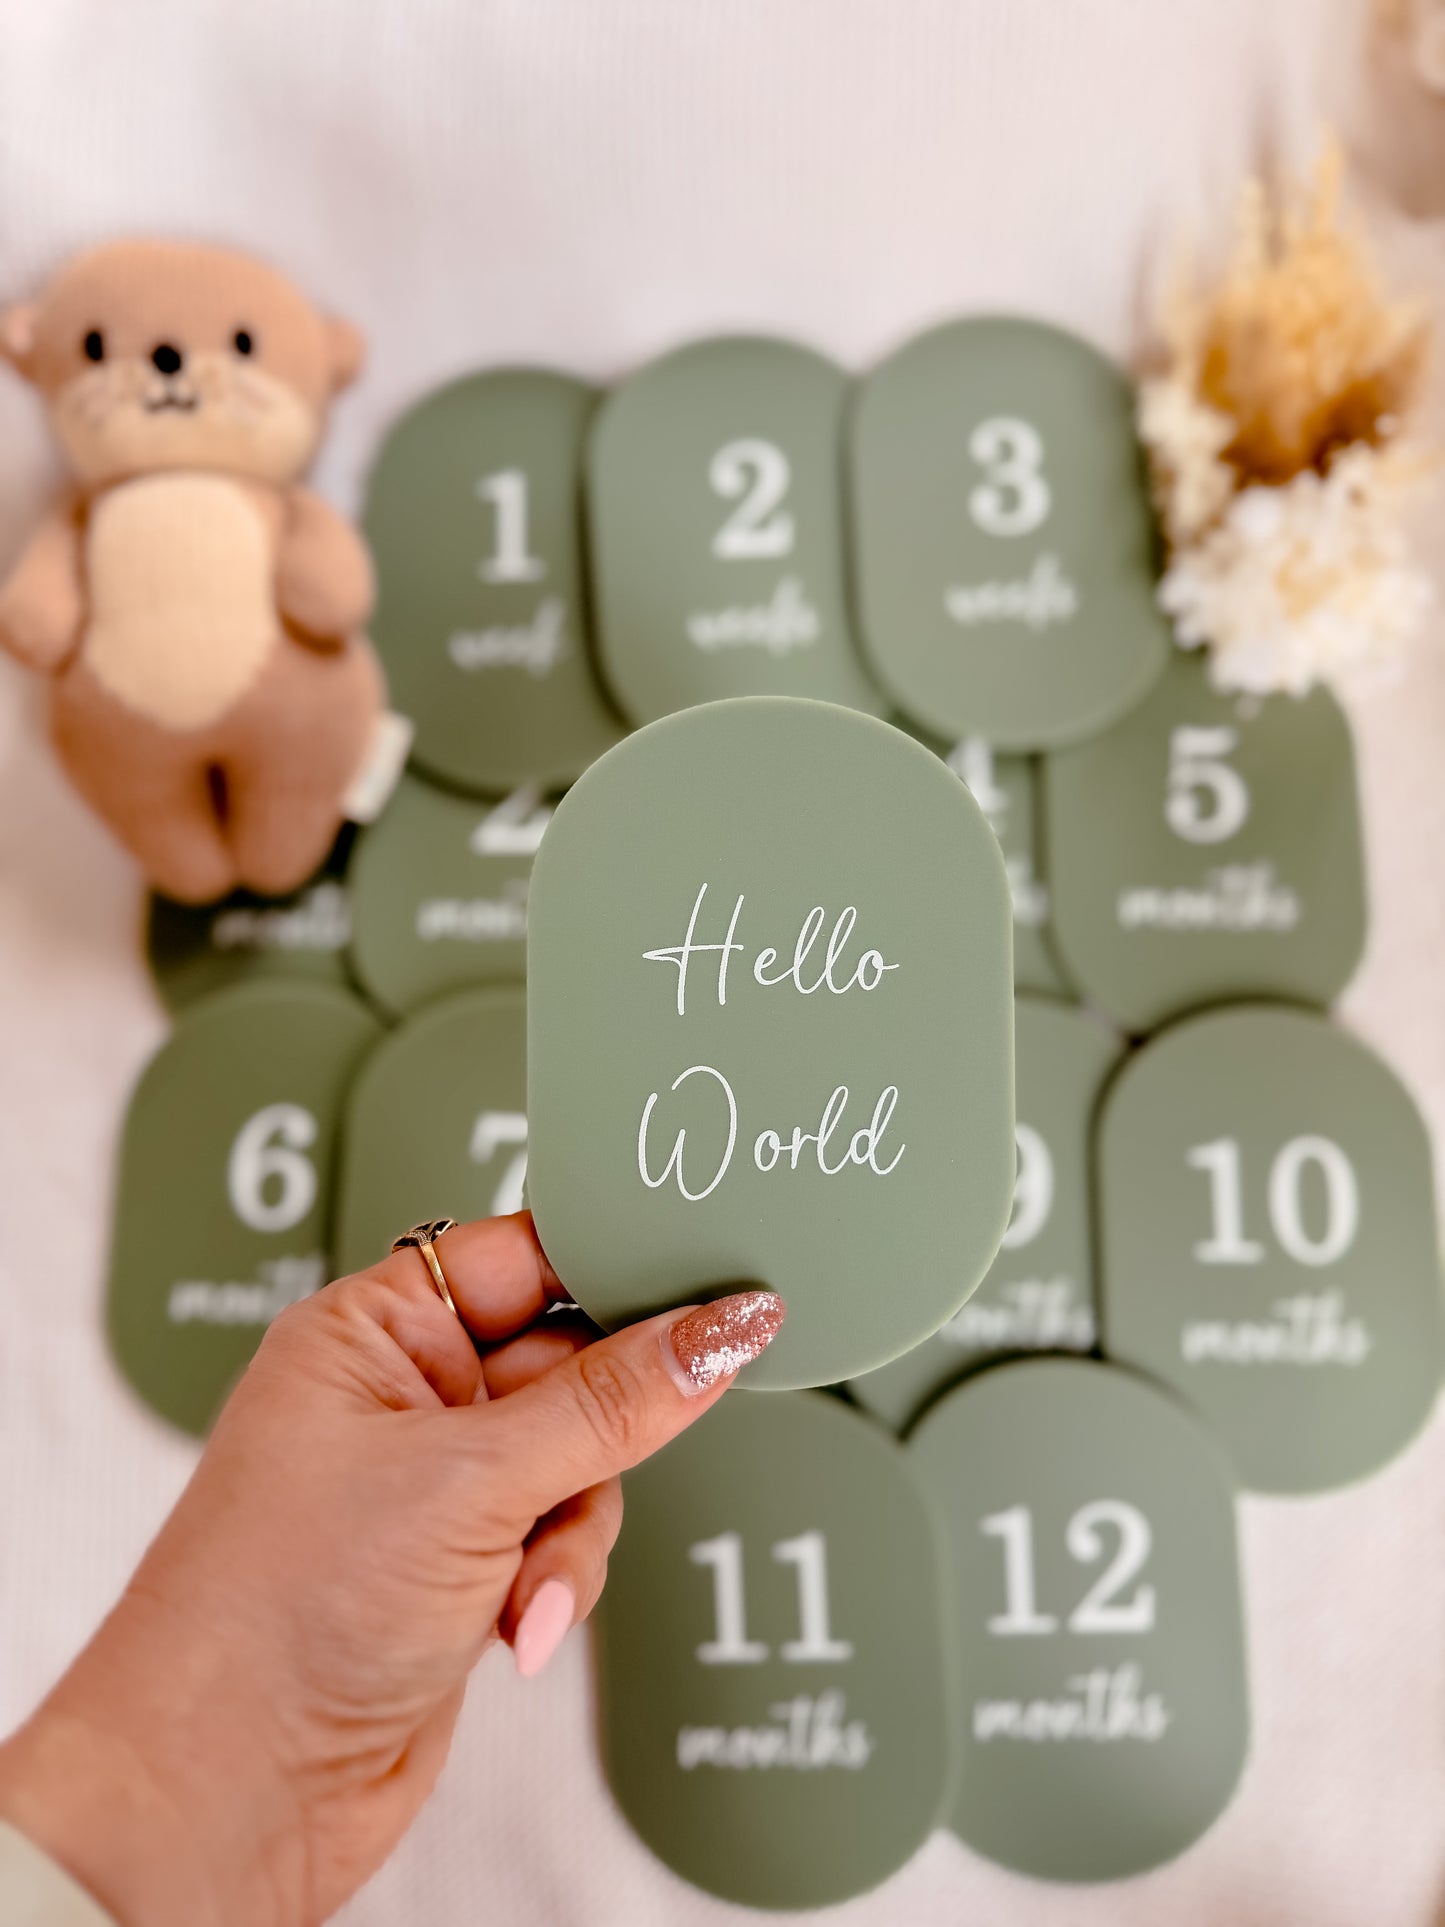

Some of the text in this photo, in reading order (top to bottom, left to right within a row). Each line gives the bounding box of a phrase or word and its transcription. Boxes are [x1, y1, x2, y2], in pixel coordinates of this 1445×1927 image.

[476, 468, 547, 584] 1
[708, 438, 796, 560] 2
[967, 416, 1051, 537] 3
[1164, 724, 1250, 844] 5
[642, 882, 900, 1016] Hello
[1116, 862, 1302, 932] months
[226, 1102, 317, 1233] 6
[638, 1065, 906, 1201] World
[1188, 1134, 1360, 1268] 10
[1181, 1288, 1375, 1368] months
[690, 1529, 855, 1665] 11
[983, 1498, 1158, 1635] 12
[677, 1686, 877, 1772] months
[973, 1658, 1175, 1743] months
